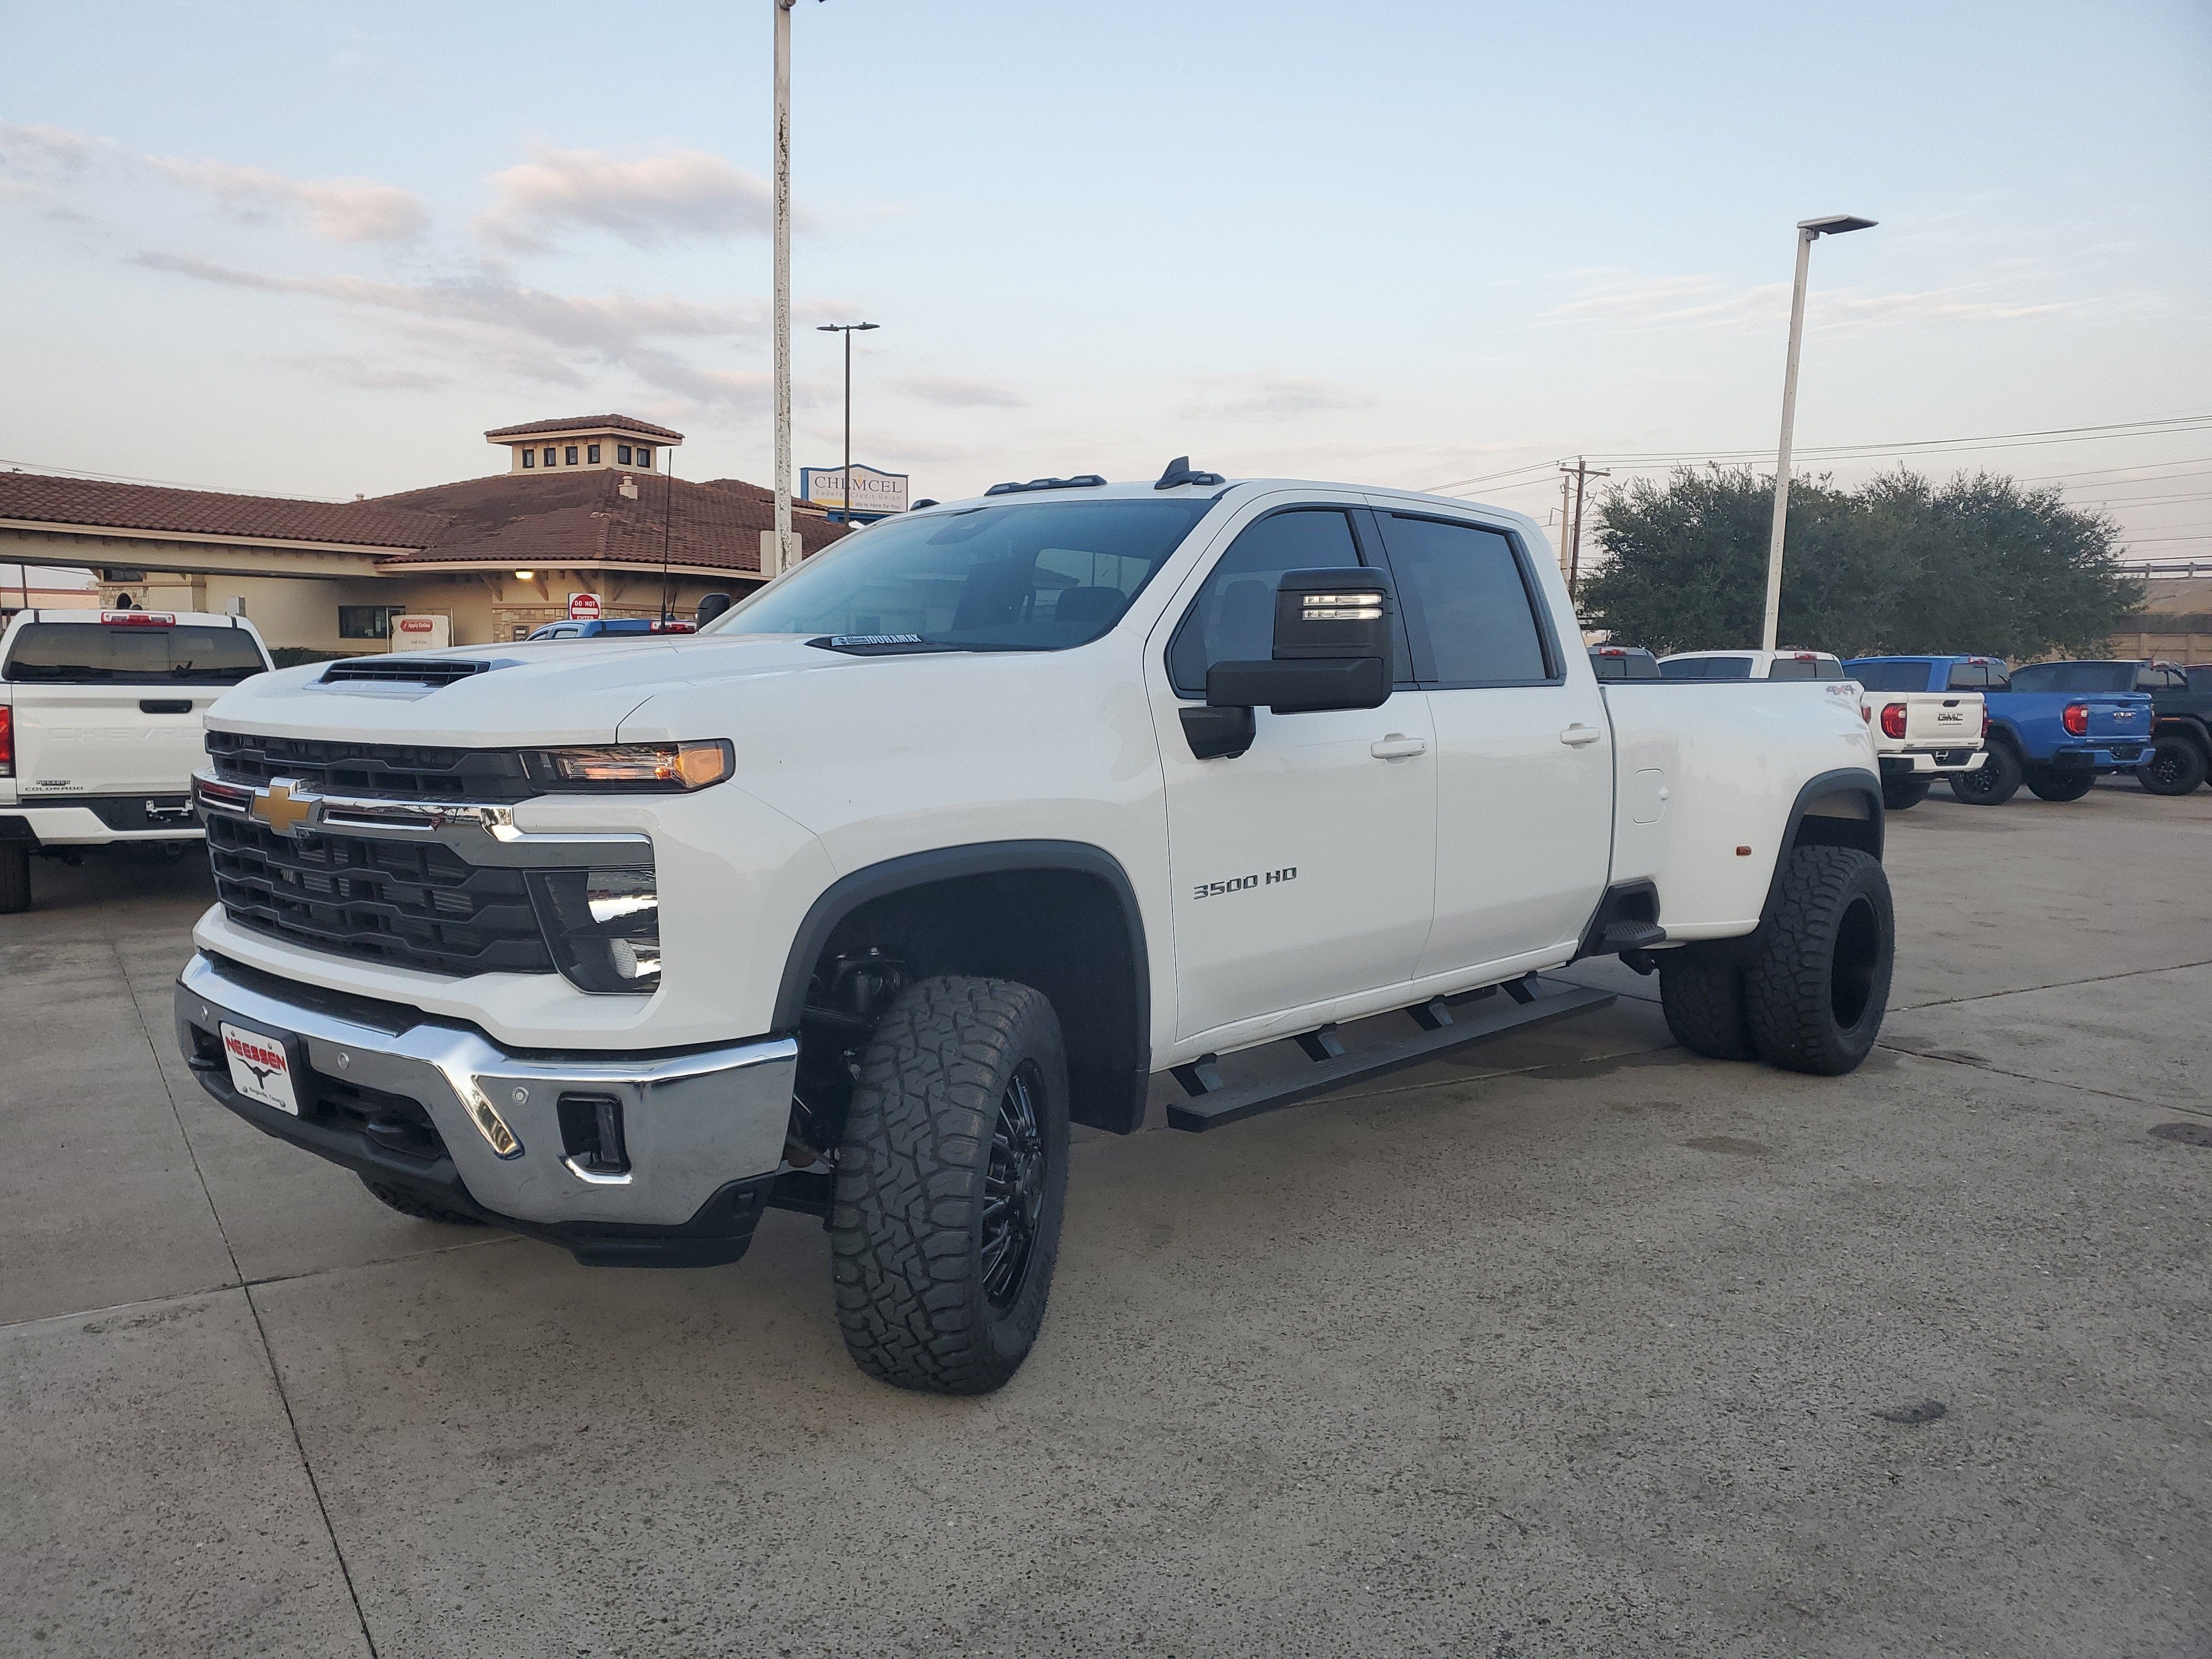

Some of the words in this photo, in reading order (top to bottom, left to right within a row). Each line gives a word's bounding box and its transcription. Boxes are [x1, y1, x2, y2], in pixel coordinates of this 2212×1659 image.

[816, 489, 844, 498] Federa
[870, 634, 923, 645] DURAMAX
[1193, 874, 1259, 900] 3500
[1266, 867, 1297, 885] HD
[225, 1036, 287, 1073] NEESSEN
